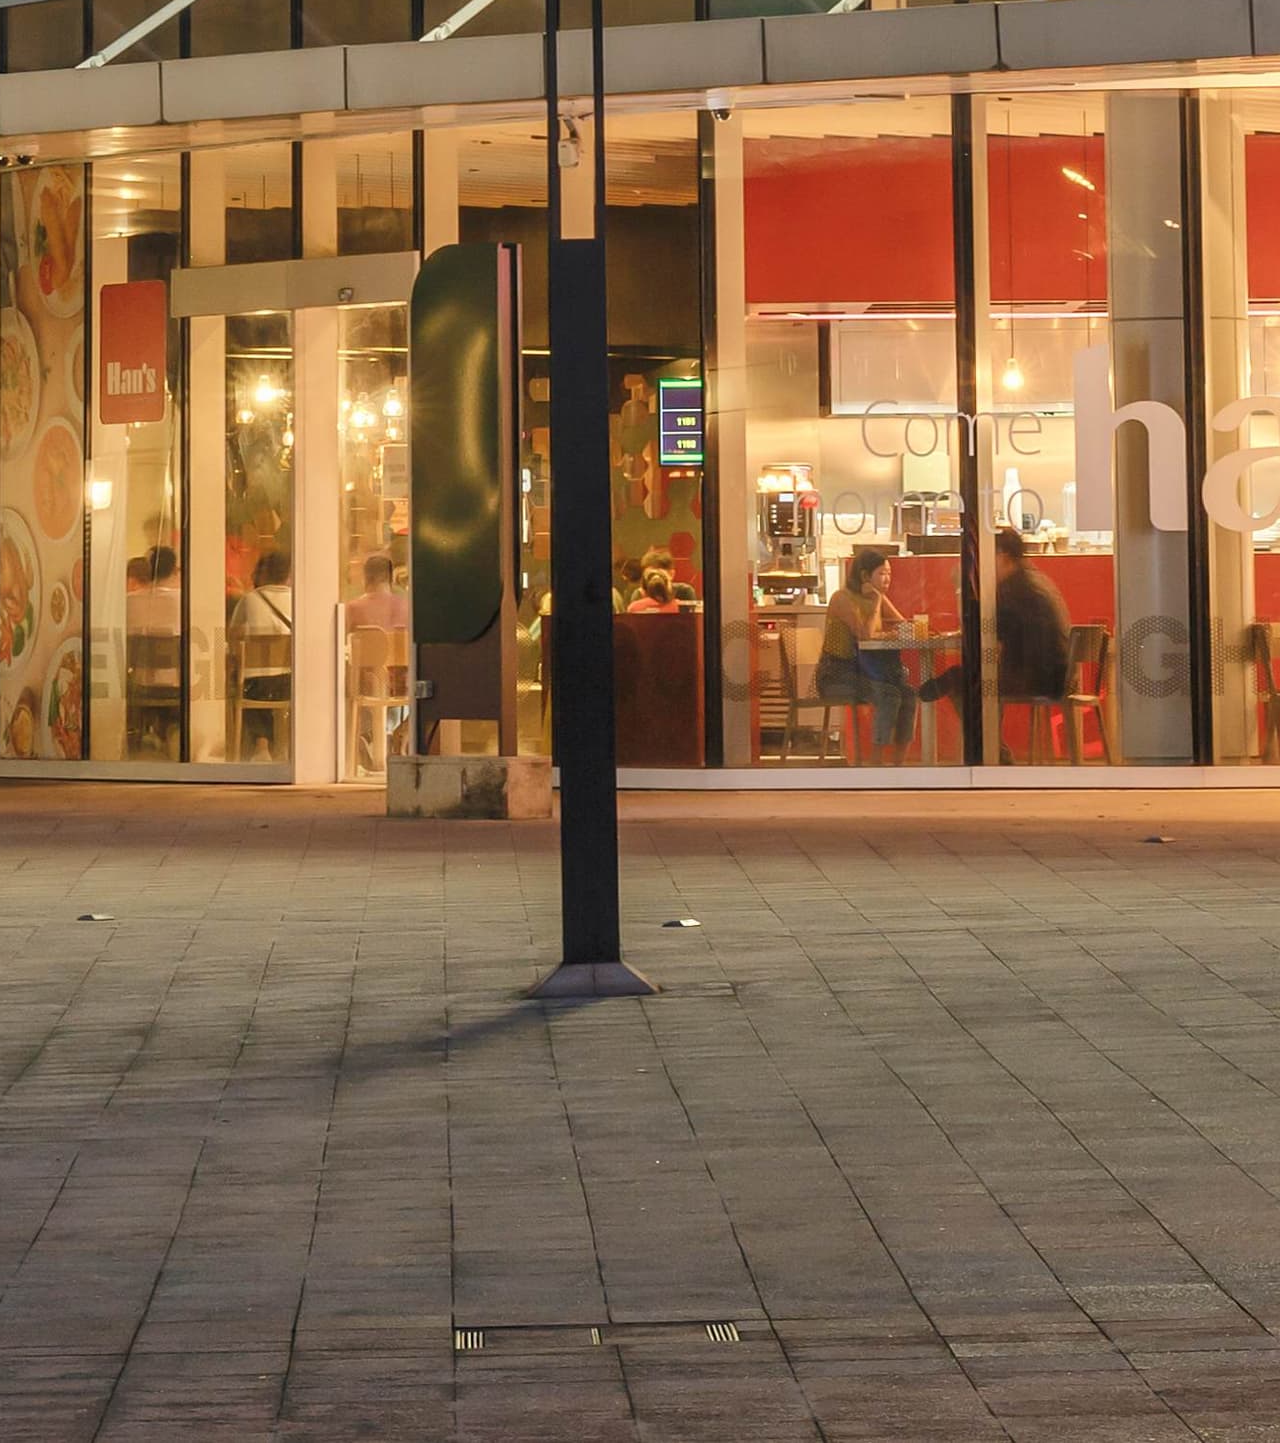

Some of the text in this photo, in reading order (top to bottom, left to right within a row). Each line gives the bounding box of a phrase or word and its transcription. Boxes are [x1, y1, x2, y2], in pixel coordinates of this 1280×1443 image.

[106, 362, 157, 396] Han's
[861, 399, 1043, 458] Come
[792, 468, 1045, 537] home to
